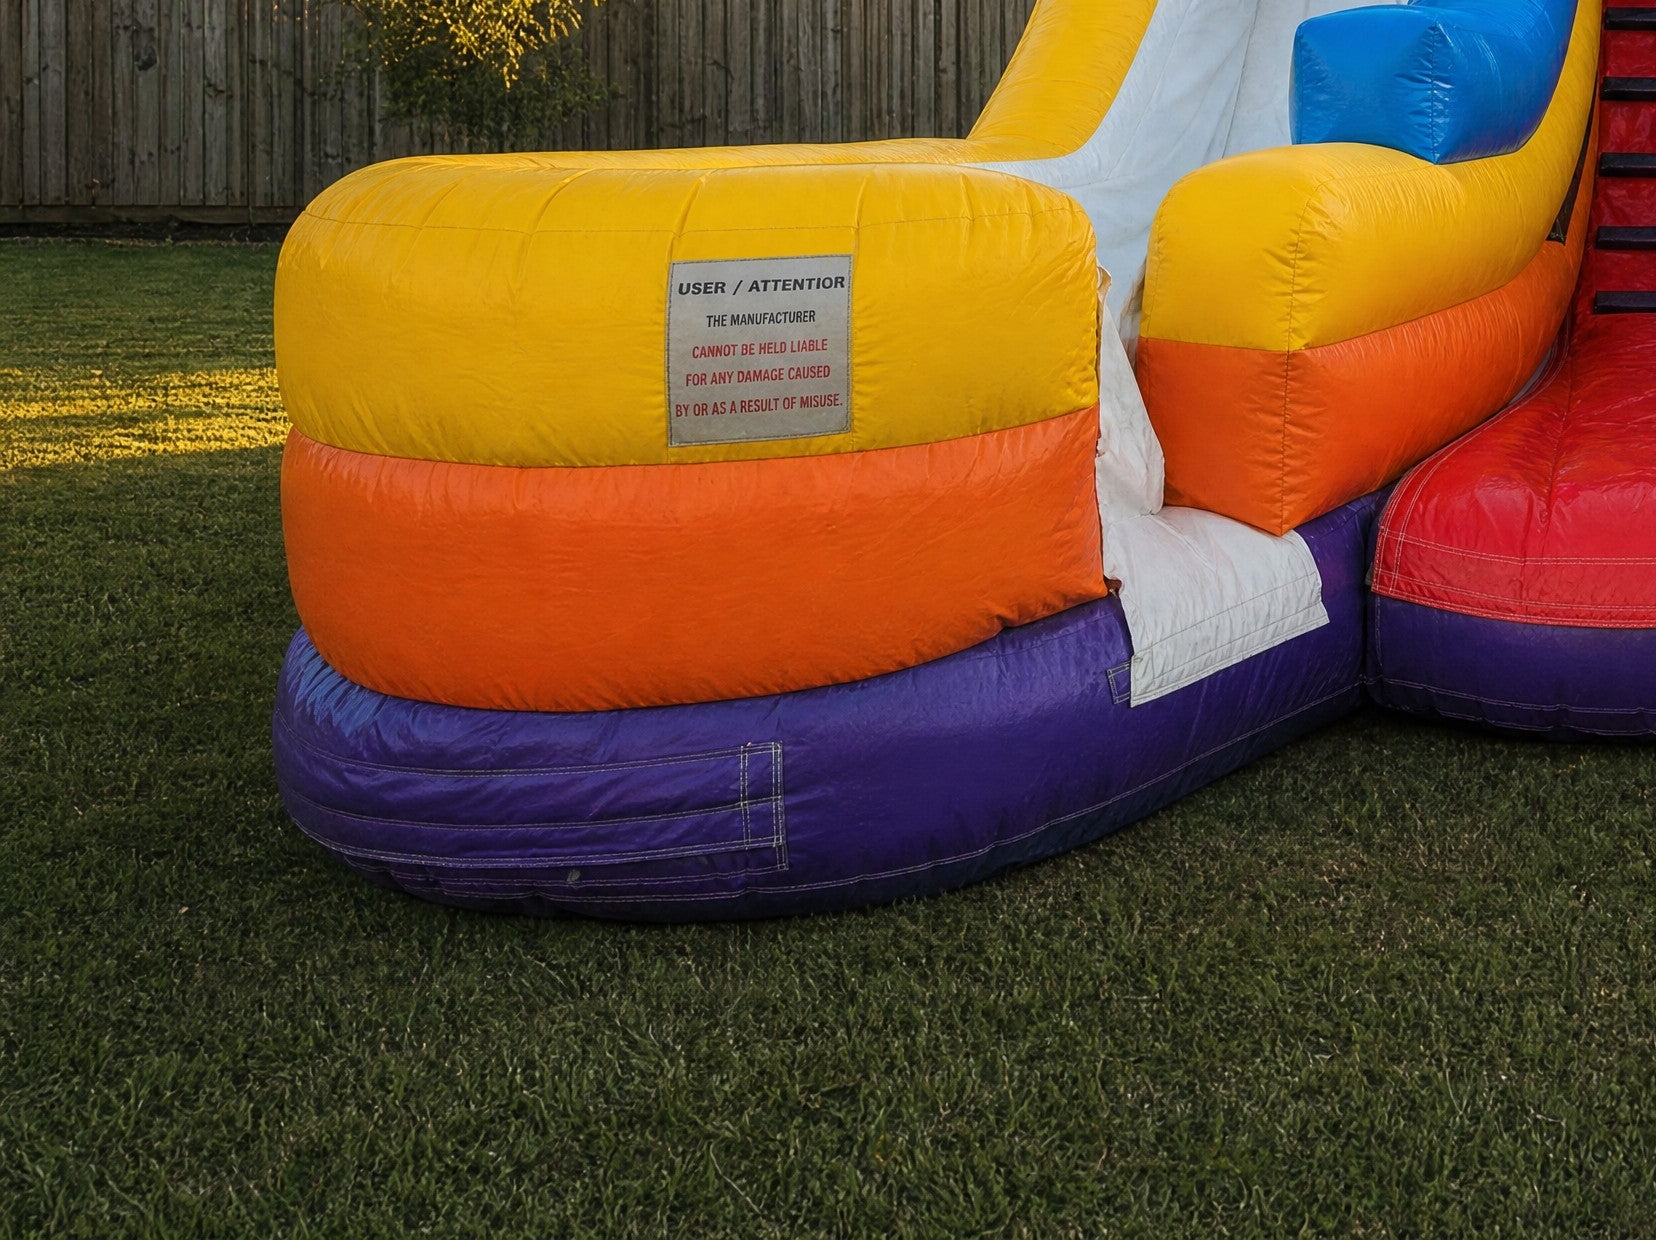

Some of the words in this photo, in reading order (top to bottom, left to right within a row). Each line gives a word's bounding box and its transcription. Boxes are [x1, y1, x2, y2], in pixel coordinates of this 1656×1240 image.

[678, 282, 725, 295] USER
[733, 280, 742, 295] /
[707, 314, 727, 327] THE
[730, 310, 815, 326] MANUFACTURER
[692, 344, 738, 358] CANNOT
[741, 343, 755, 356] BE
[759, 341, 786, 355] HELD
[791, 339, 828, 353] LIABLE
[686, 373, 707, 386] FOR
[711, 371, 734, 384] ANY
[737, 368, 784, 382] DAMAGE
[788, 365, 830, 379] CAUSED
[676, 404, 689, 418] BY
[693, 403, 708, 416] OR
[712, 402, 726, 415] AS
[730, 401, 737, 413] A
[740, 398, 780, 413] RESULT
[783, 396, 797, 410] OF
[800, 394, 843, 408] MISUSE.
